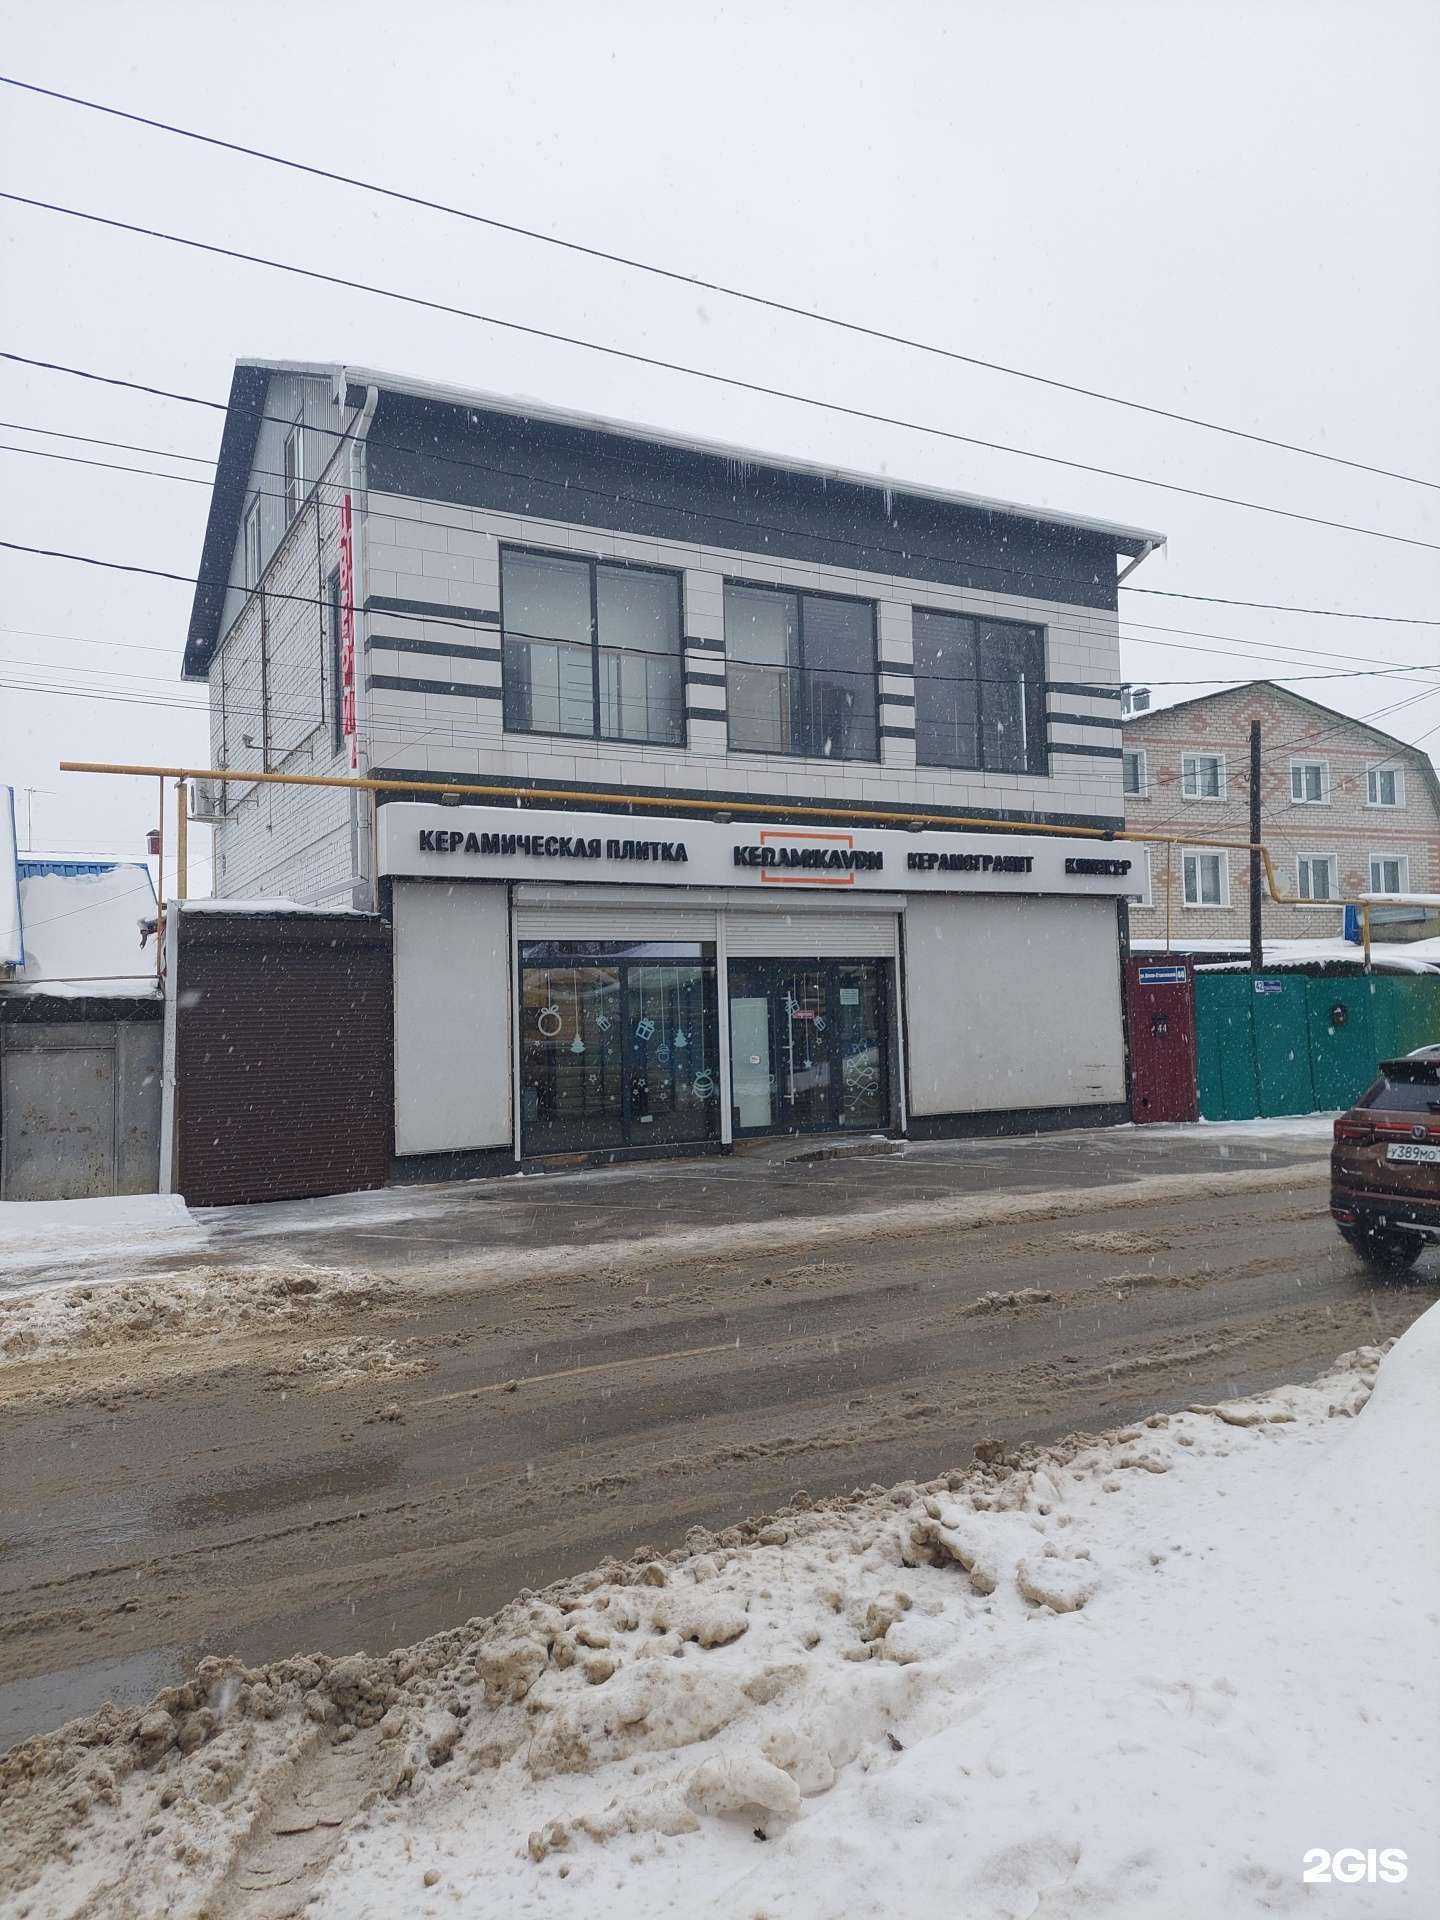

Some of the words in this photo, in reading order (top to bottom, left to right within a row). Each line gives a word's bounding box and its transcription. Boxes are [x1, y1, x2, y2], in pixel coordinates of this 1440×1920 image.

[419, 828, 601, 859] КЕРАМИЧЕСКАЯ
[606, 838, 689, 863] ПЛИТКА
[907, 852, 1035, 873] КЕРАМОГРАНИТ
